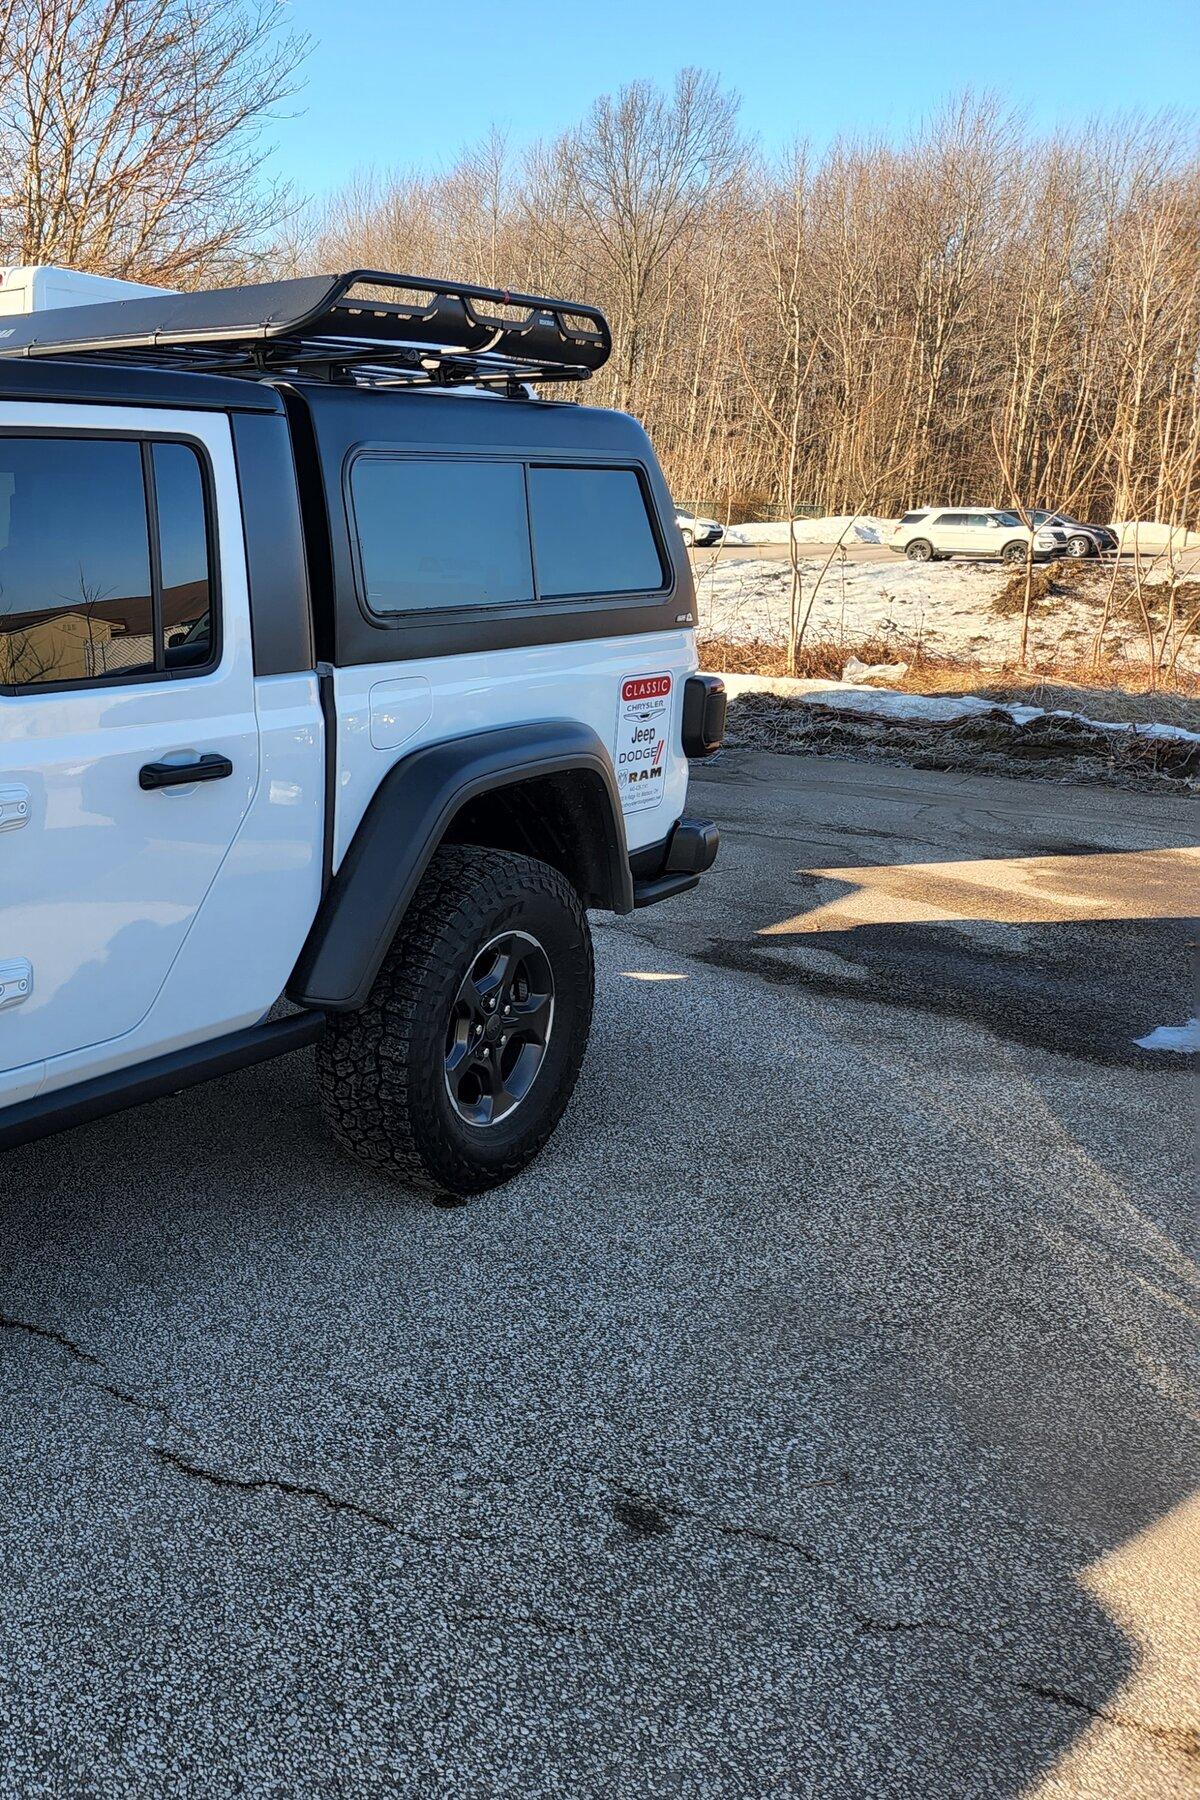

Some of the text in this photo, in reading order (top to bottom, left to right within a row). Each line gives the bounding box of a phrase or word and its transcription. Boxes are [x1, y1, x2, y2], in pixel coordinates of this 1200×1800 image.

[625, 679, 669, 697] CLASSIC
[626, 700, 664, 712] CHRYSLER
[631, 726, 656, 745] Jeep
[619, 746, 658, 764] DODGE
[628, 767, 662, 783] RAM
